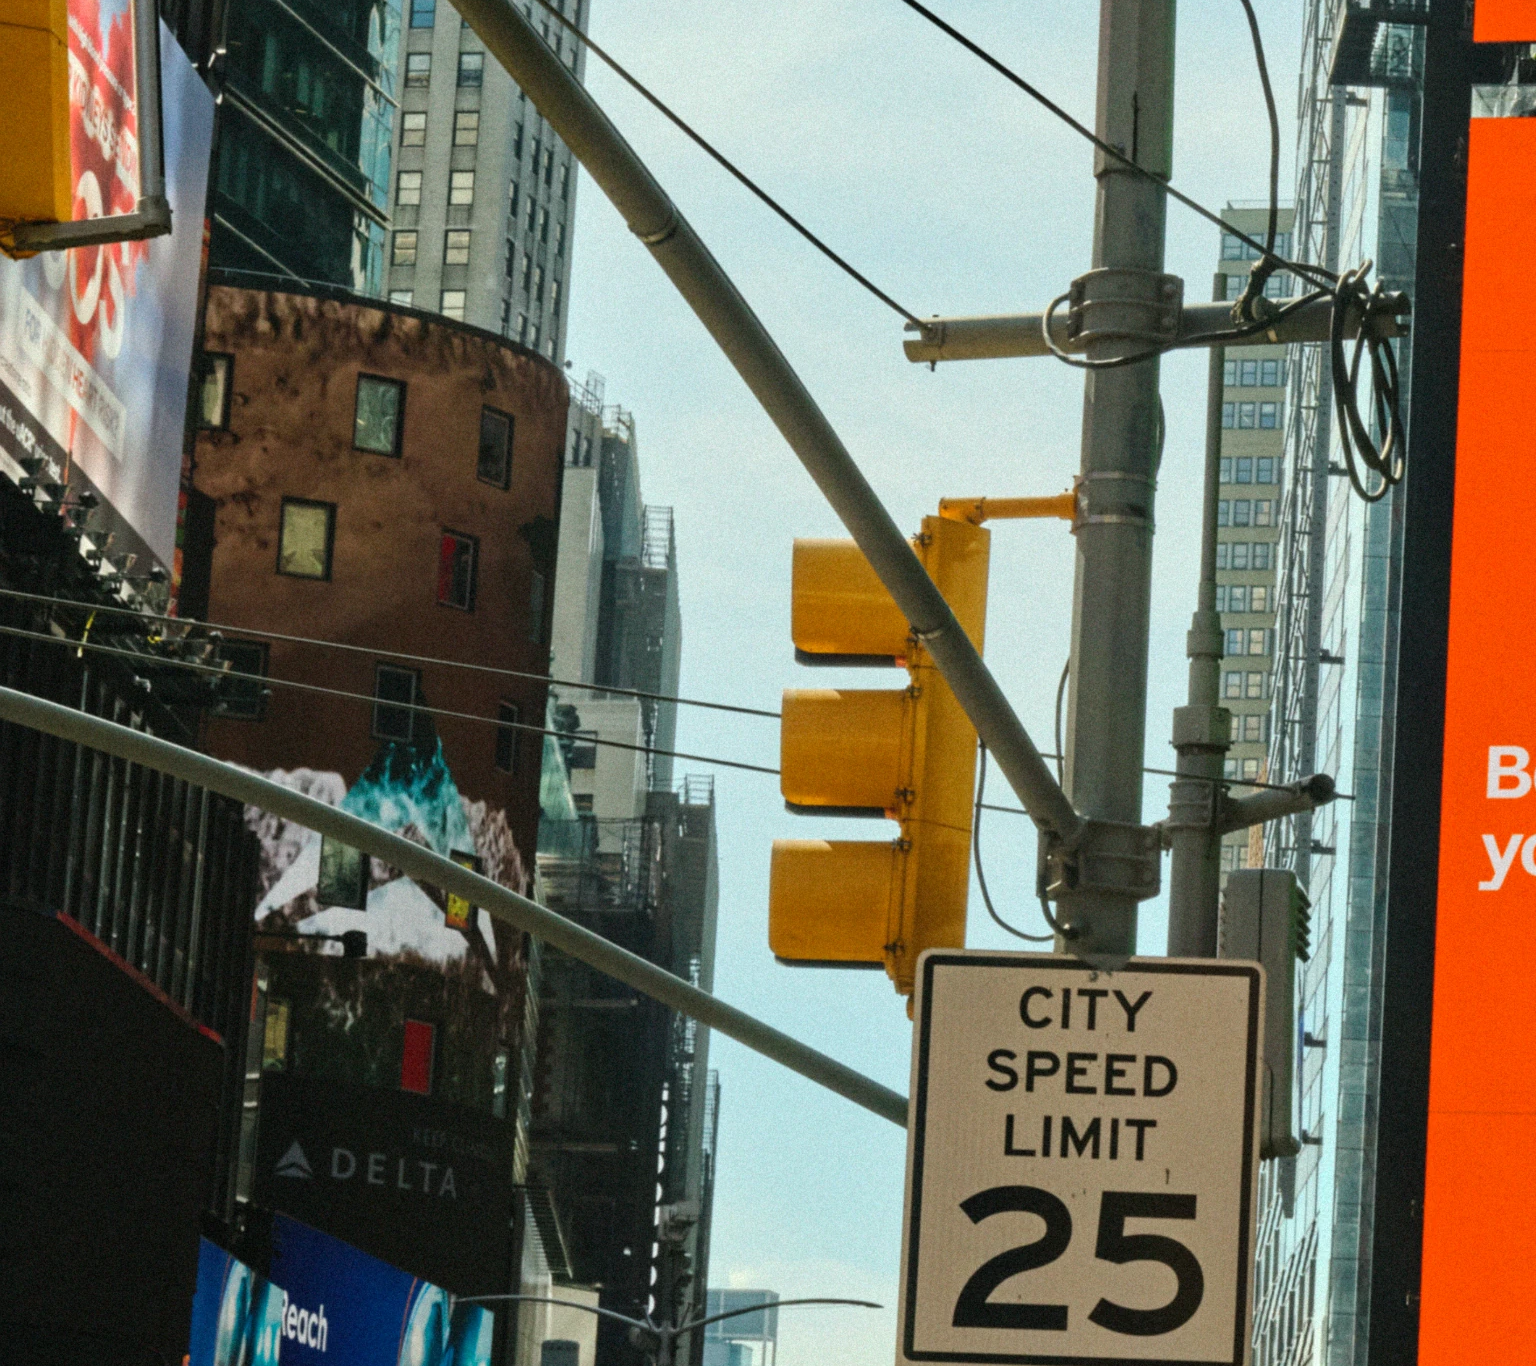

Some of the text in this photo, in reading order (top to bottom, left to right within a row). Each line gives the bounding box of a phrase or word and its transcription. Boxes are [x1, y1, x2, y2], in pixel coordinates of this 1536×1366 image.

[1019, 986, 1152, 1032] CITY
[984, 1050, 1178, 1097] SPEED
[1003, 1114, 1157, 1161] LIMIT
[331, 1147, 457, 1199] DELTA
[952, 1184, 1205, 1337] 25
